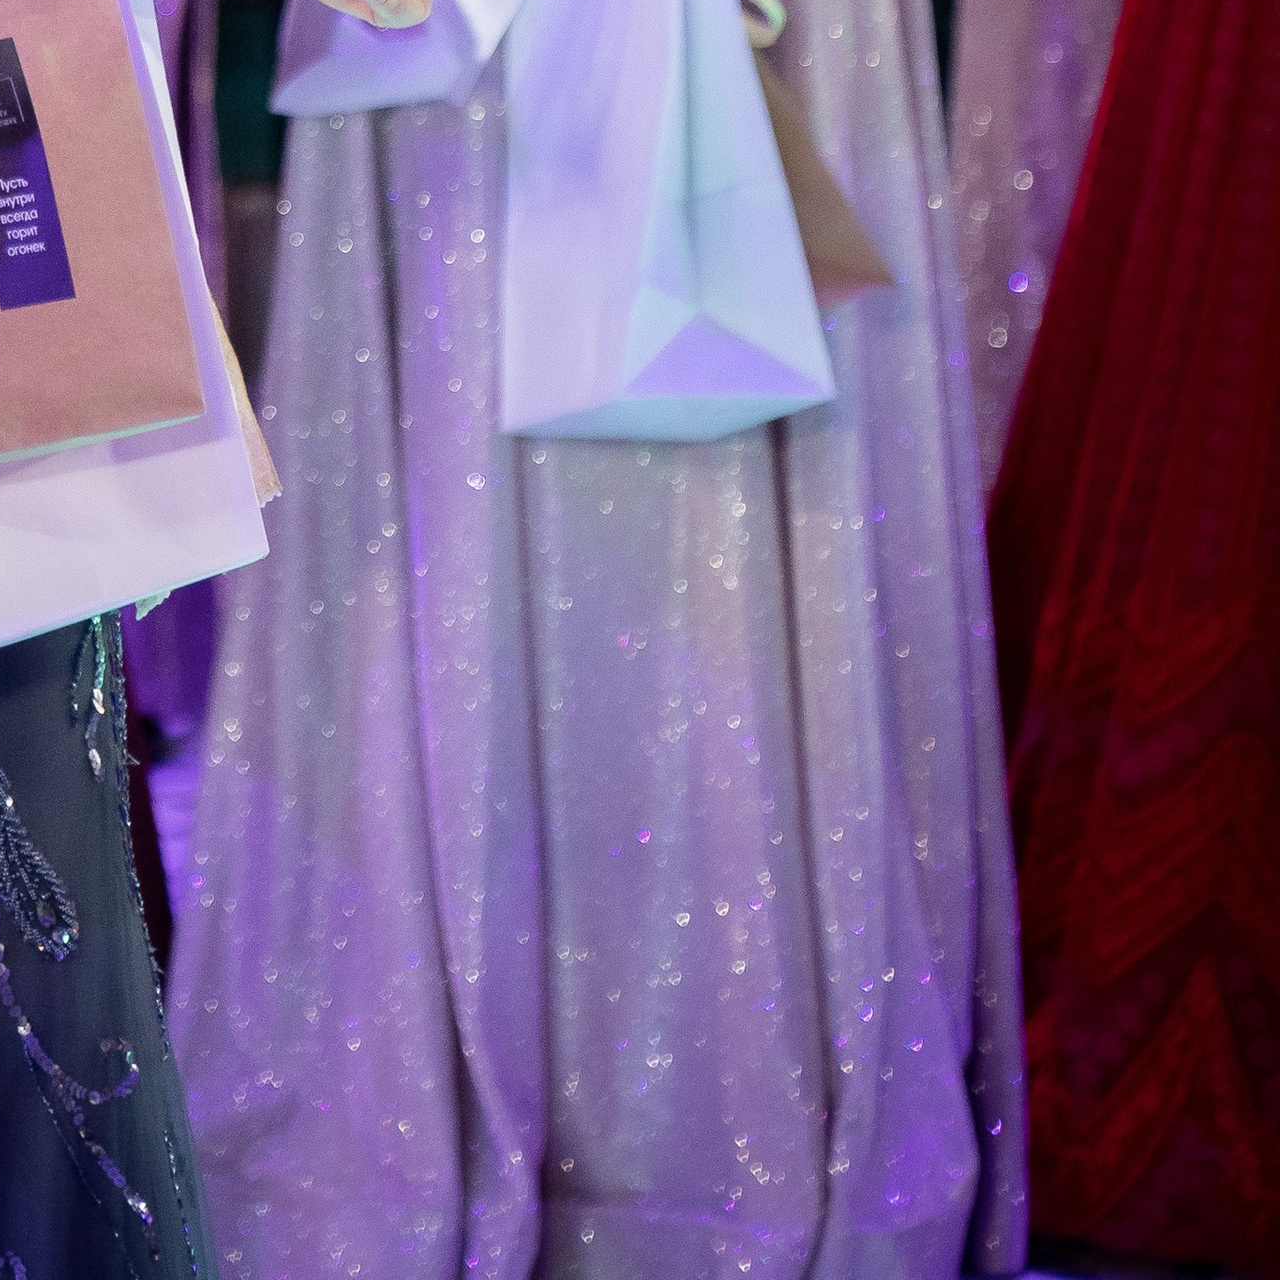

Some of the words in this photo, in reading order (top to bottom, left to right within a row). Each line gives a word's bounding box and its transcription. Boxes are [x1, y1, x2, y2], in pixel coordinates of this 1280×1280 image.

[0, 209, 38, 225] всегда
[7, 226, 38, 241] горит
[7, 241, 46, 257] огонек
